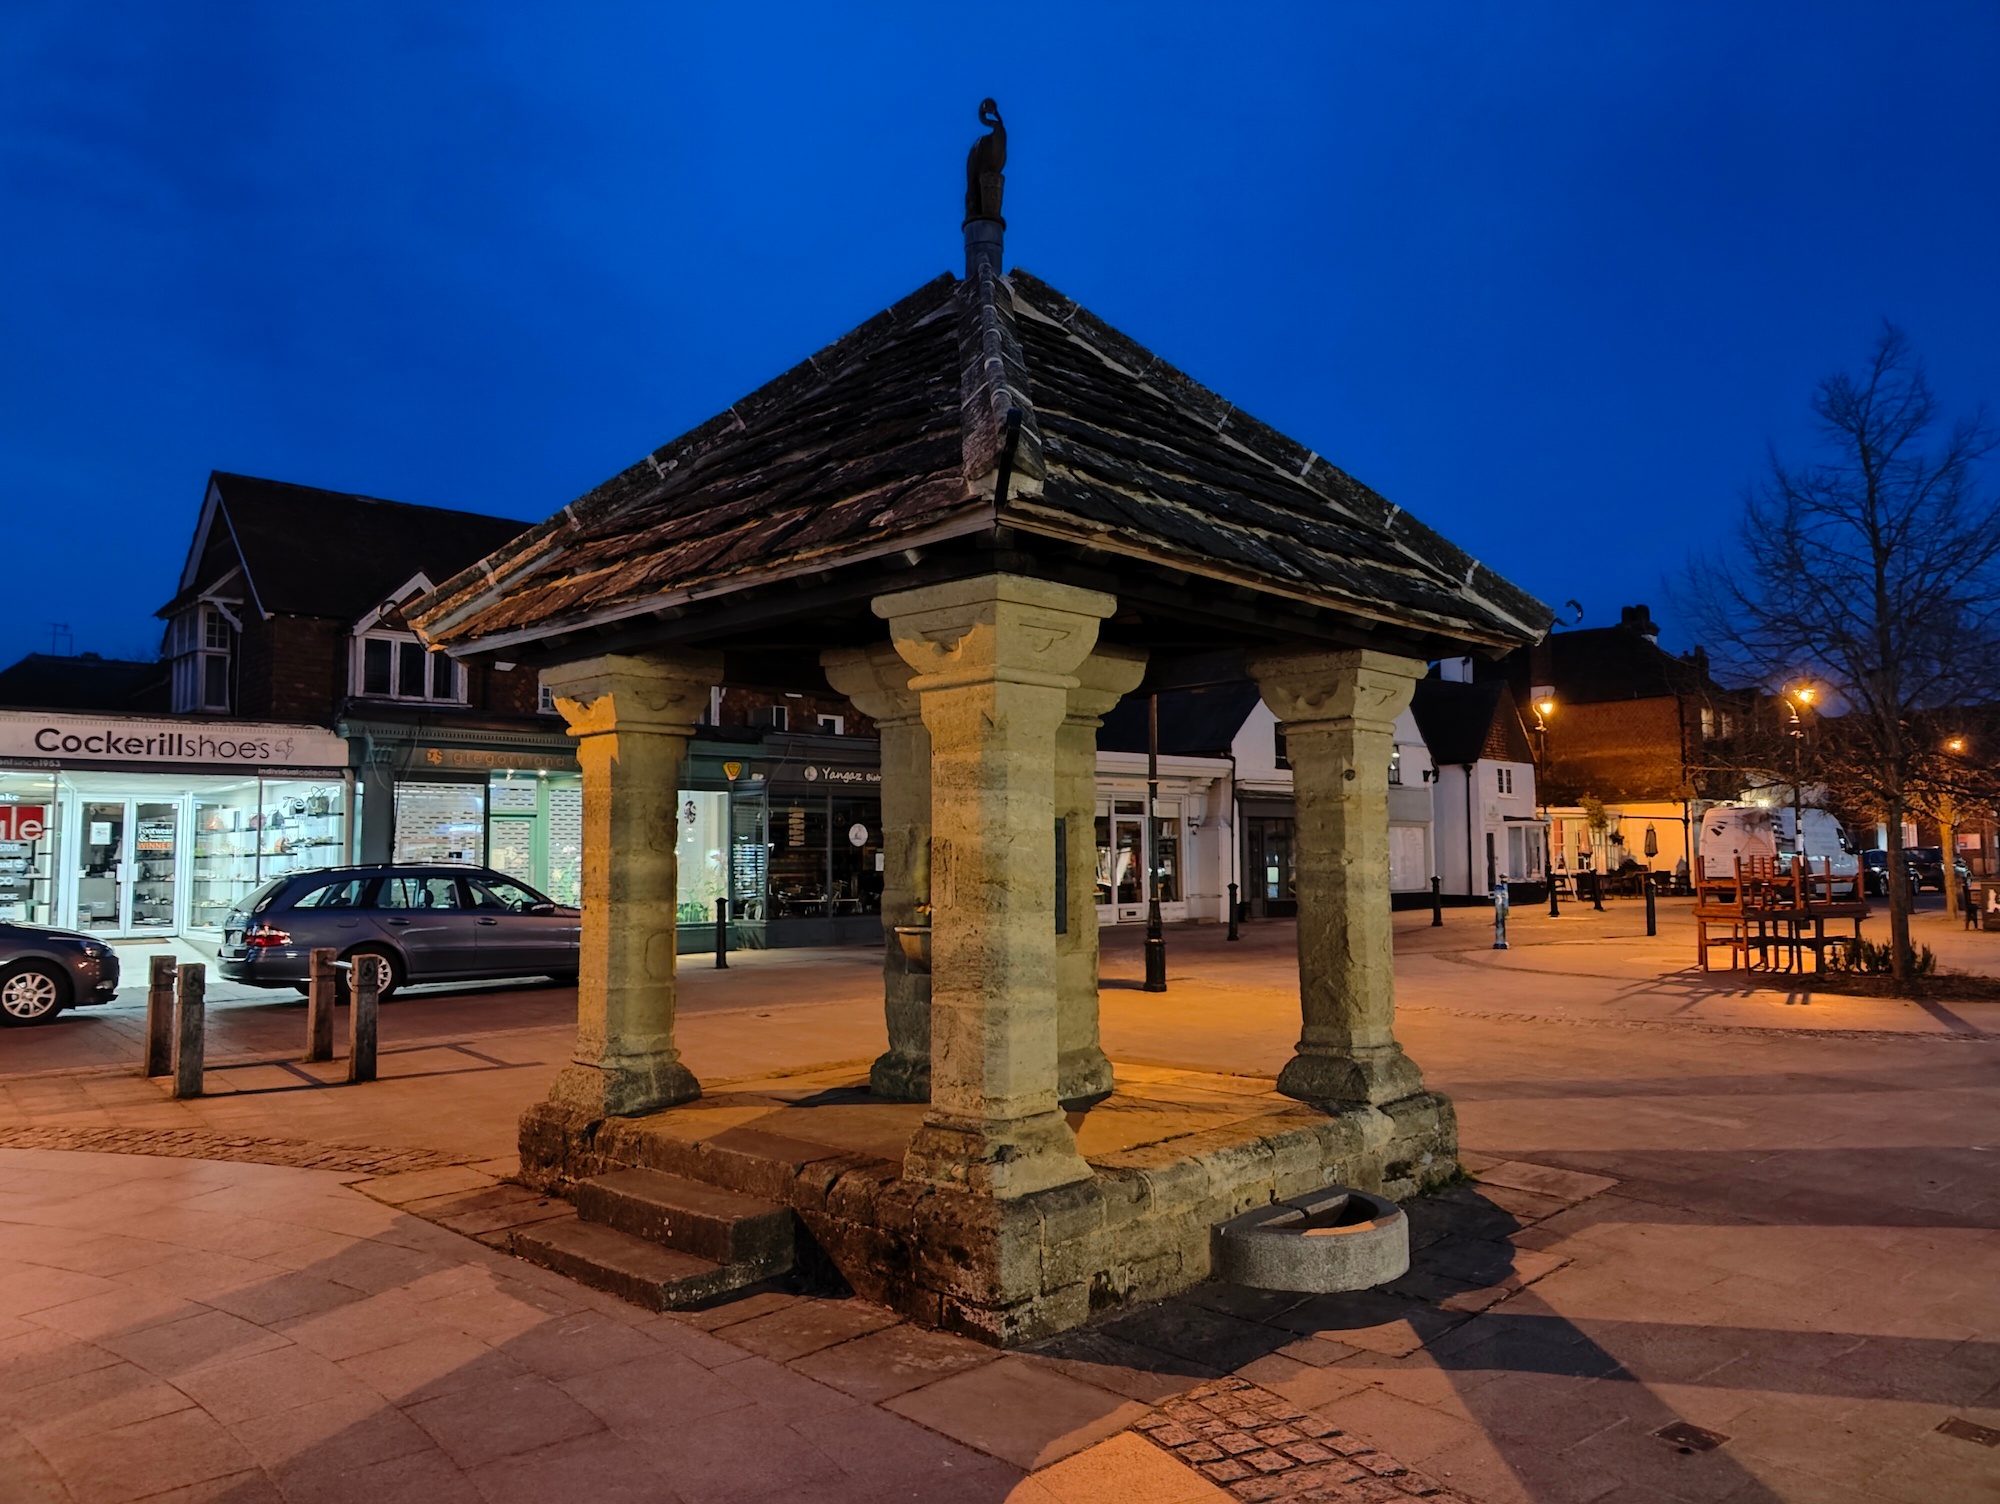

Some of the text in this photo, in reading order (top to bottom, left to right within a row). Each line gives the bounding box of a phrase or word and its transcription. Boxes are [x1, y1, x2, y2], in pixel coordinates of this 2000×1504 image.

[35, 728, 269, 759] Cockerillshoes
[453, 752, 524, 766] gregory
[822, 767, 862, 783] Yangaz
